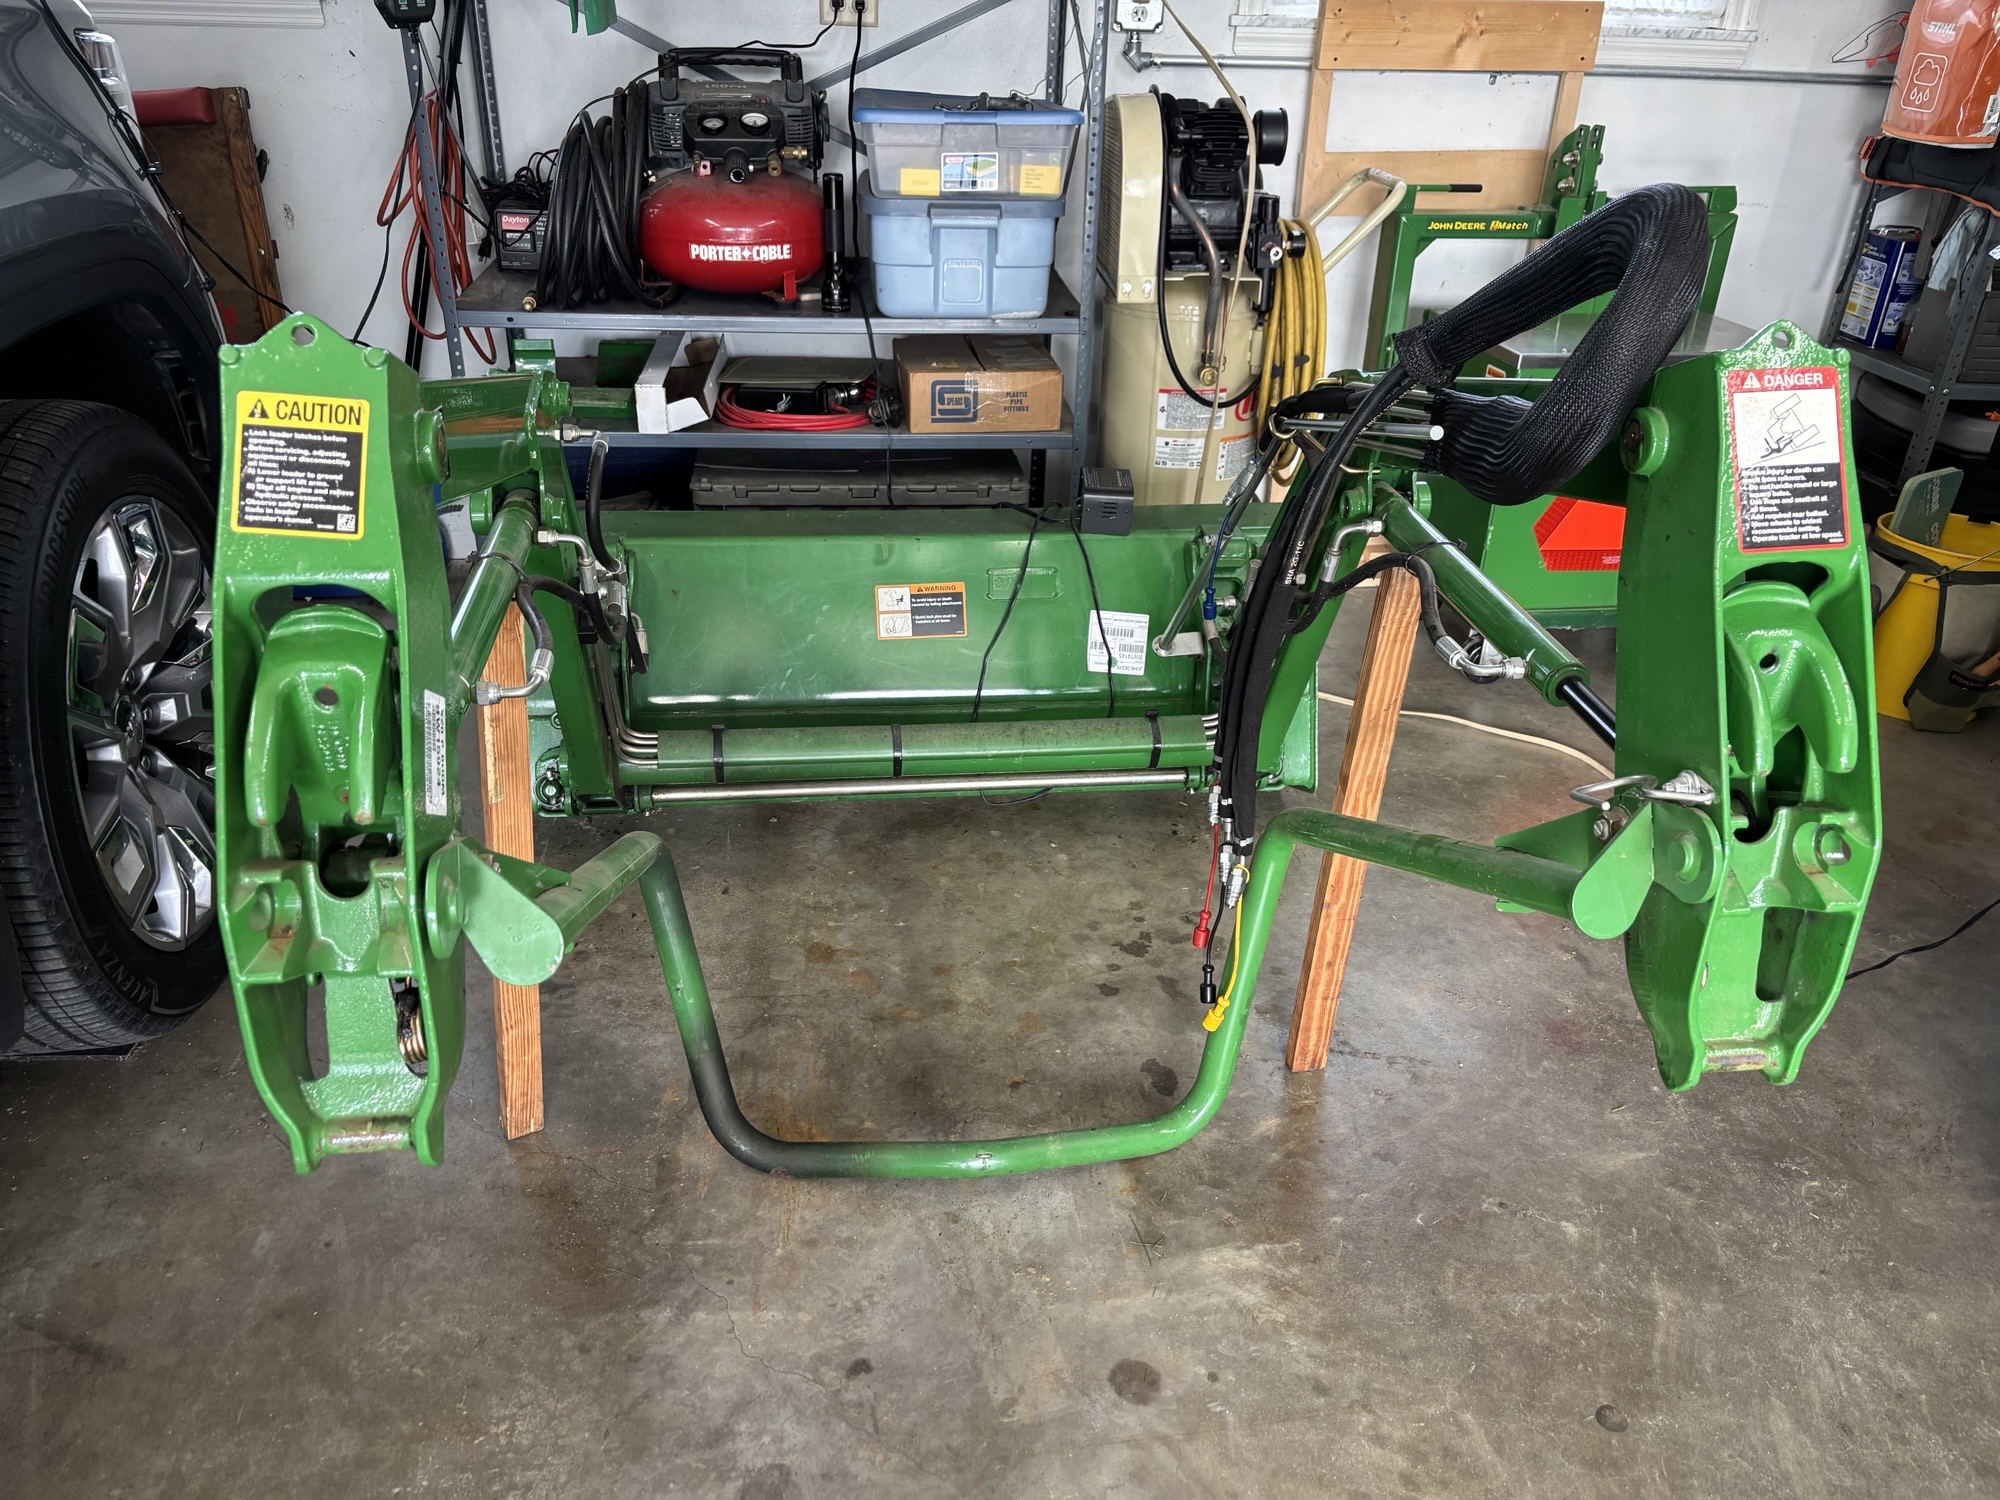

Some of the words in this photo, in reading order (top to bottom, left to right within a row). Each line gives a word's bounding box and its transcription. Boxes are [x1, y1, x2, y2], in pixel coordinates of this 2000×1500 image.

[1927, 21, 1956, 35] STIHL
[502, 215, 530, 224] Dayton
[1428, 221, 1453, 230] JOHN
[1454, 221, 1486, 230] DEERE
[1764, 372, 1823, 387] DANGER
[946, 396, 963, 406] SPEARS
[276, 400, 361, 426] CAUTION
[312, 449, 346, 458] adjusting
[247, 452, 287, 461] equipment
[298, 456, 350, 466] disconnecting
[265, 476, 294, 485] support
[316, 472, 342, 481] ground
[287, 486, 312, 494] engine
[245, 498, 276, 506] Observe
[1751, 526, 1797, 534] recommended
[1951, 673, 1985, 690] FISKAR
[96, 941, 151, 1003] ALENZA
